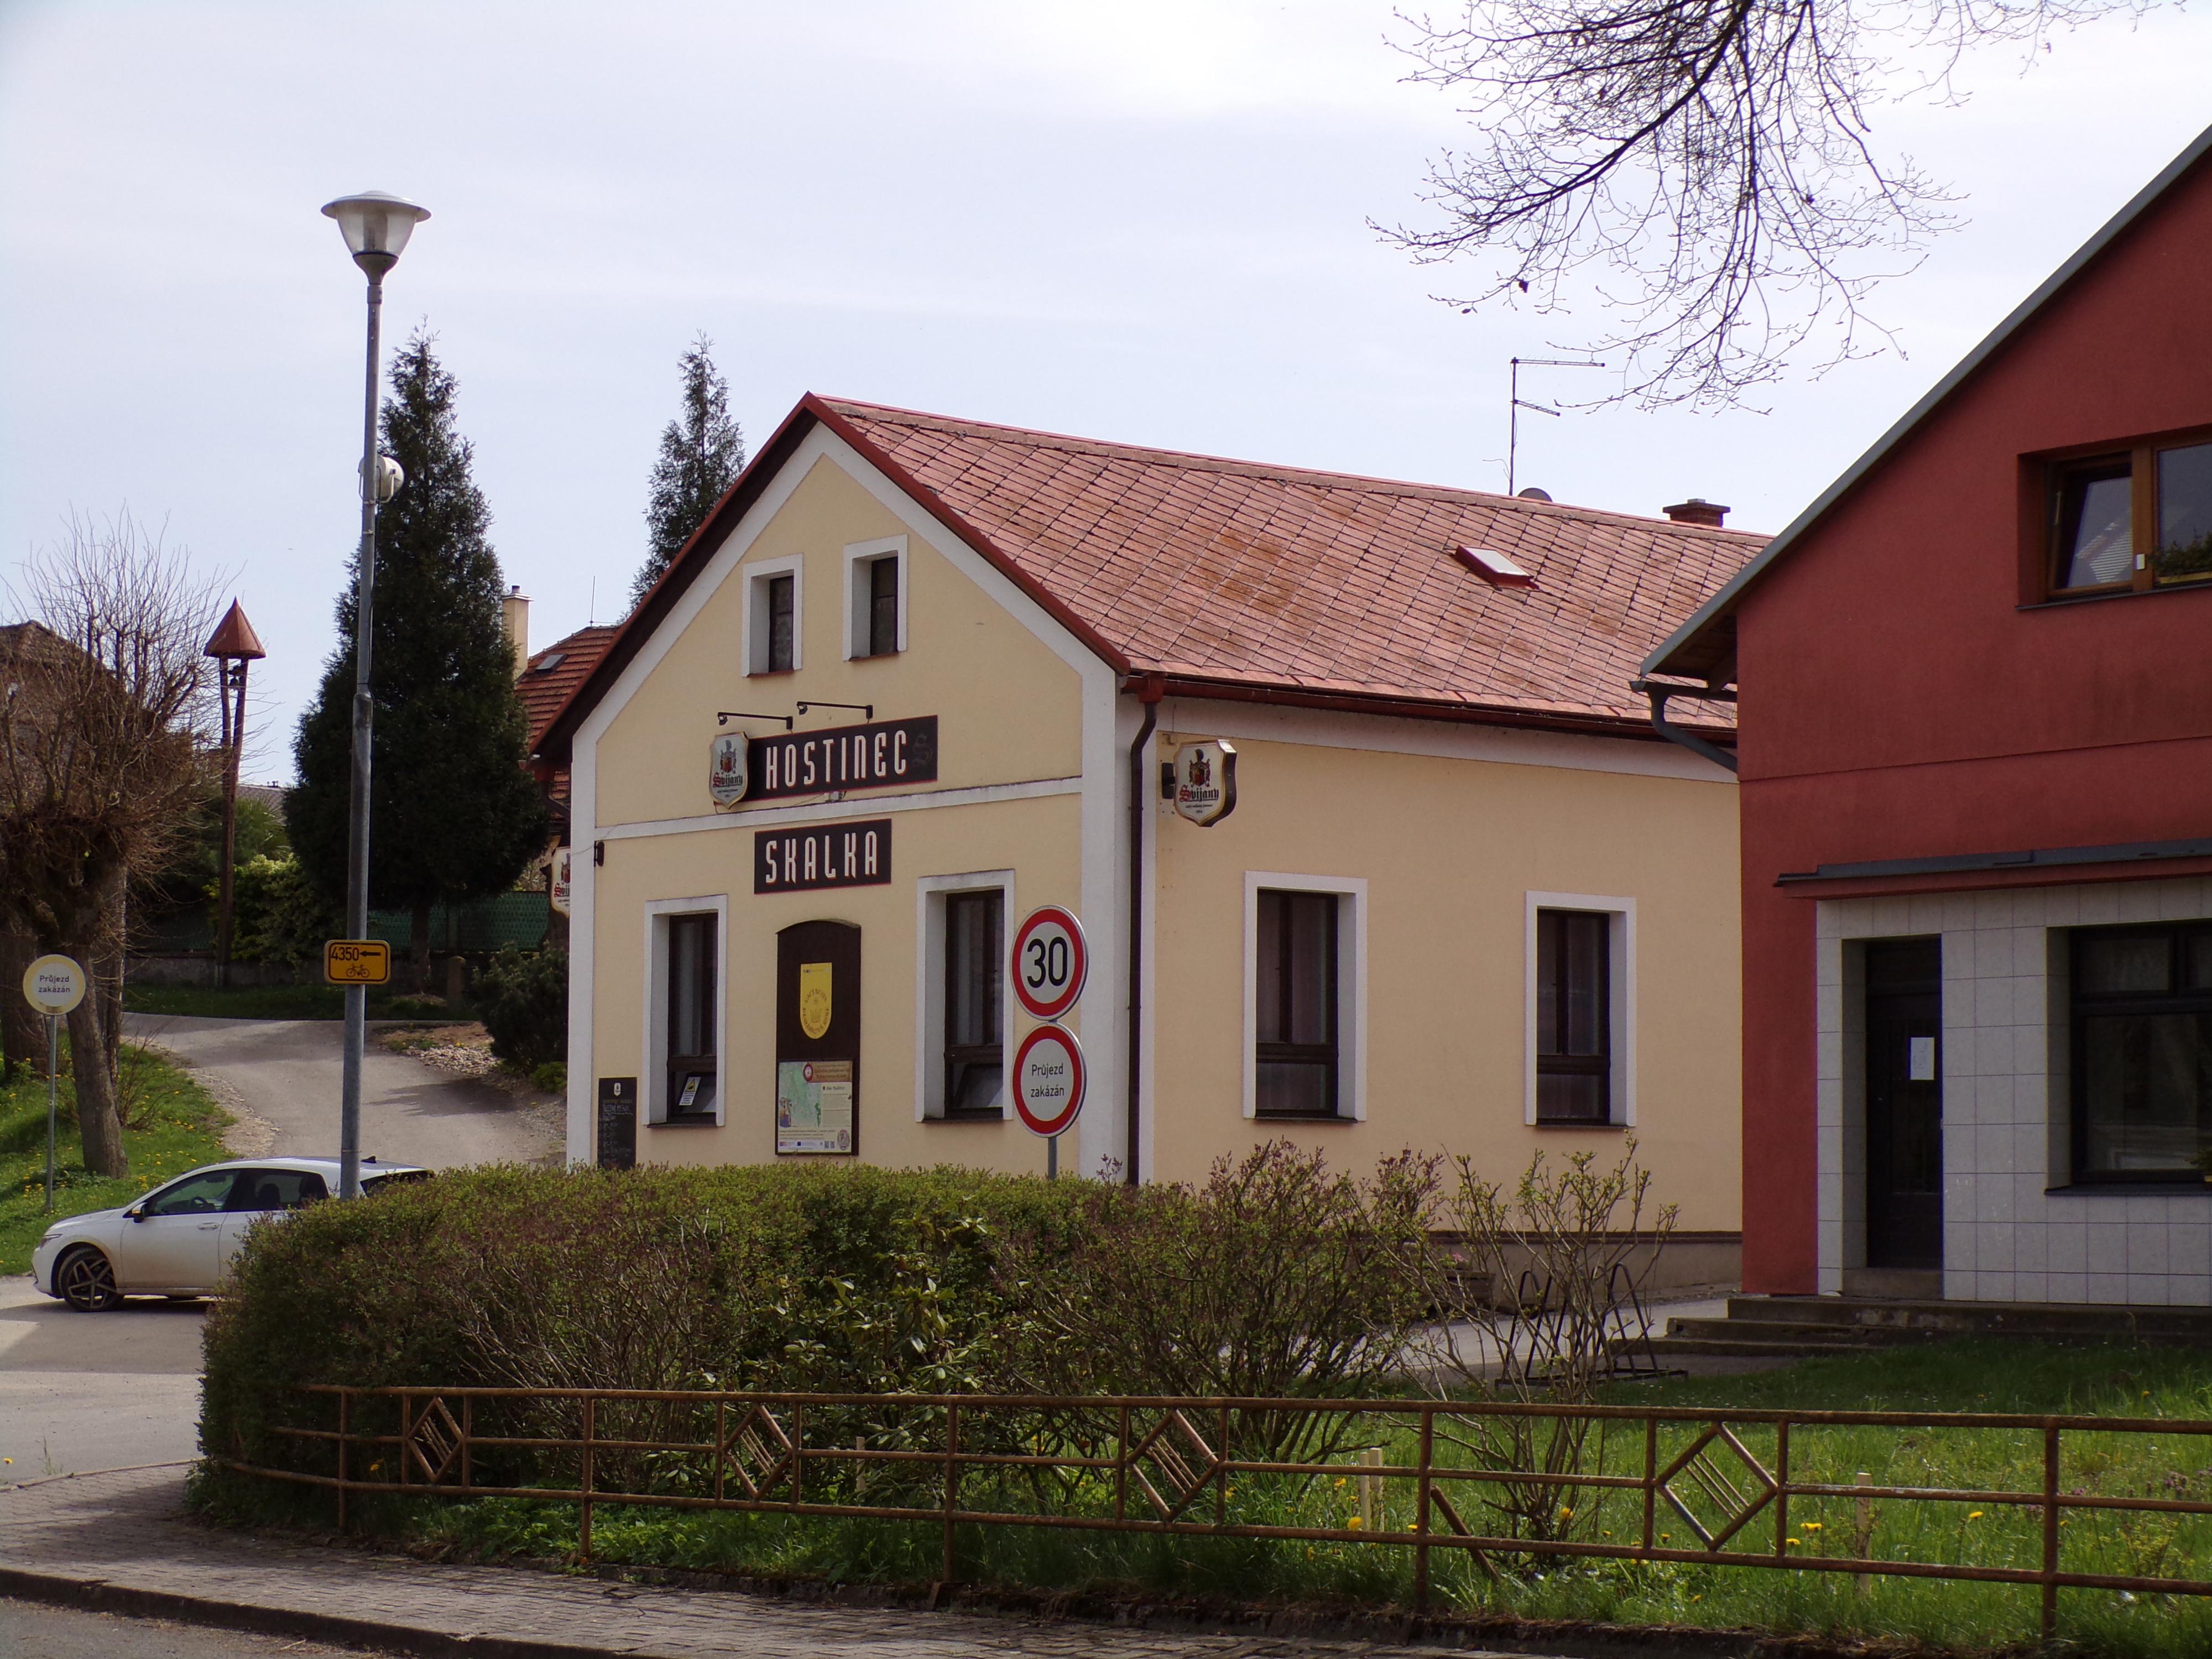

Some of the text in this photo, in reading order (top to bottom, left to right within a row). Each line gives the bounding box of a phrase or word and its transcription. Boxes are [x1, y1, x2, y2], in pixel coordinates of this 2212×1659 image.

[765, 730, 907, 790] HOSTINEC
[712, 772, 743, 788] Svijany
[1178, 784, 1219, 802] Svijany
[765, 831, 878, 884] SKALKA
[331, 946, 359, 961] 4350
[1027, 936, 1068, 988] 30
[39, 974, 70, 984] Průjezd
[1031, 1062, 1064, 1079] Průjezd
[1030, 1084, 1065, 1098] zakázán
